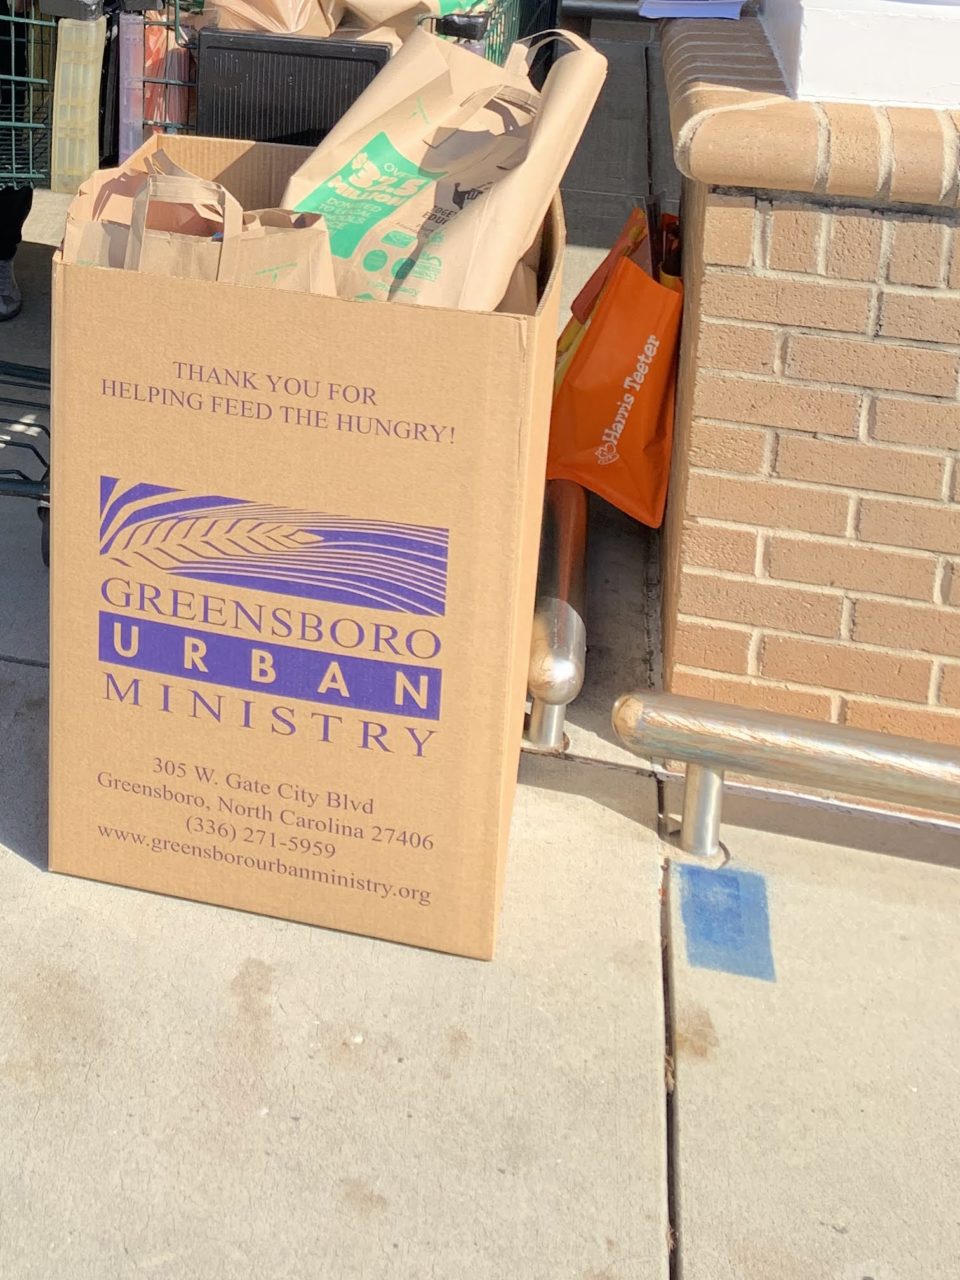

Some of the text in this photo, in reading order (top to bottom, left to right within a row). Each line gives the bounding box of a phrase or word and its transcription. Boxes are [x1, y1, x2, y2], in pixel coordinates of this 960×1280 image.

[100, 378, 456, 446] HELPING FEED THE HUNGRY!
[172, 361, 378, 406] THANK YOU FOR
[602, 333, 661, 448] Harris Teeter
[100, 576, 442, 662] GREENSBORO
[112, 621, 429, 711] URBAN
[103, 671, 439, 759] MINISTRY
[97, 770, 435, 852] Greensboro, North Carolina 27406
[151, 756, 374, 816] 305 W. Gate City Blvd
[97, 824, 432, 907] www.greensborourbanministry.org
[185, 813, 337, 860] (336) 271-5959
